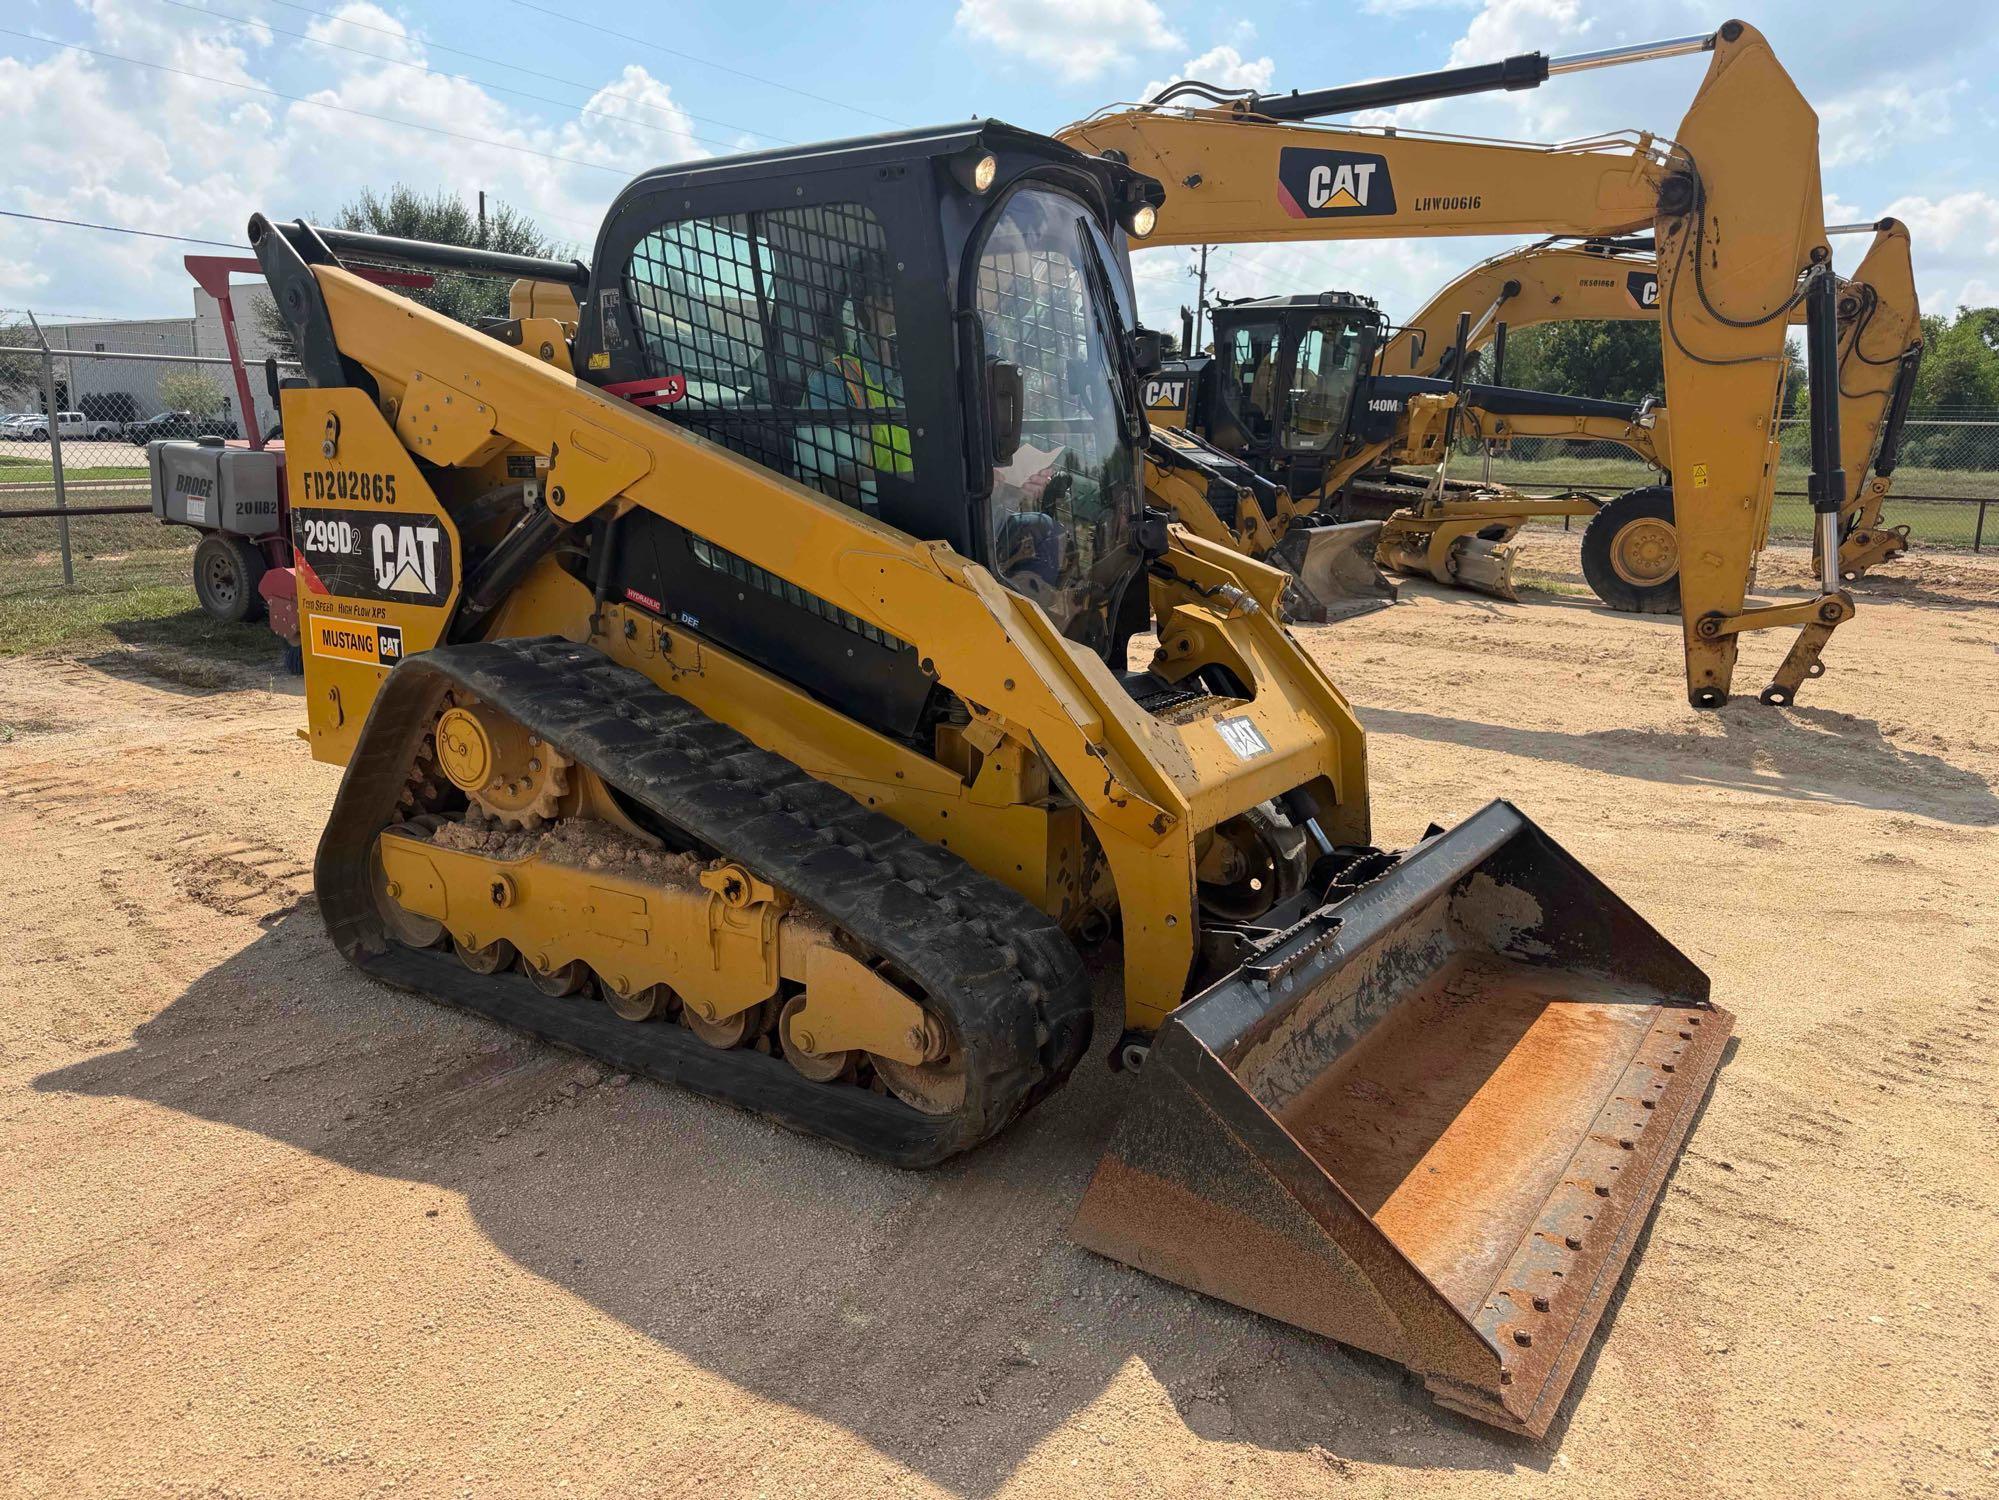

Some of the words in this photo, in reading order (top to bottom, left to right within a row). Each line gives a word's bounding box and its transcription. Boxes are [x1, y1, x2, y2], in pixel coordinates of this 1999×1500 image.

[1308, 163, 1377, 209] CAT
[1415, 195, 1481, 212] LHW00616
[1145, 381, 1185, 407] CAT
[176, 474, 213, 498] BROCE
[303, 471, 396, 505] FD202865
[371, 523, 439, 595] CAT
[627, 589, 660, 610] HYDRAULIC
[371, 607, 386, 620] XPS
[681, 613, 700, 628] DEF
[322, 629, 373, 654] MUSTANG
[379, 635, 400, 658] CAT
[1220, 719, 1267, 758] CAT
